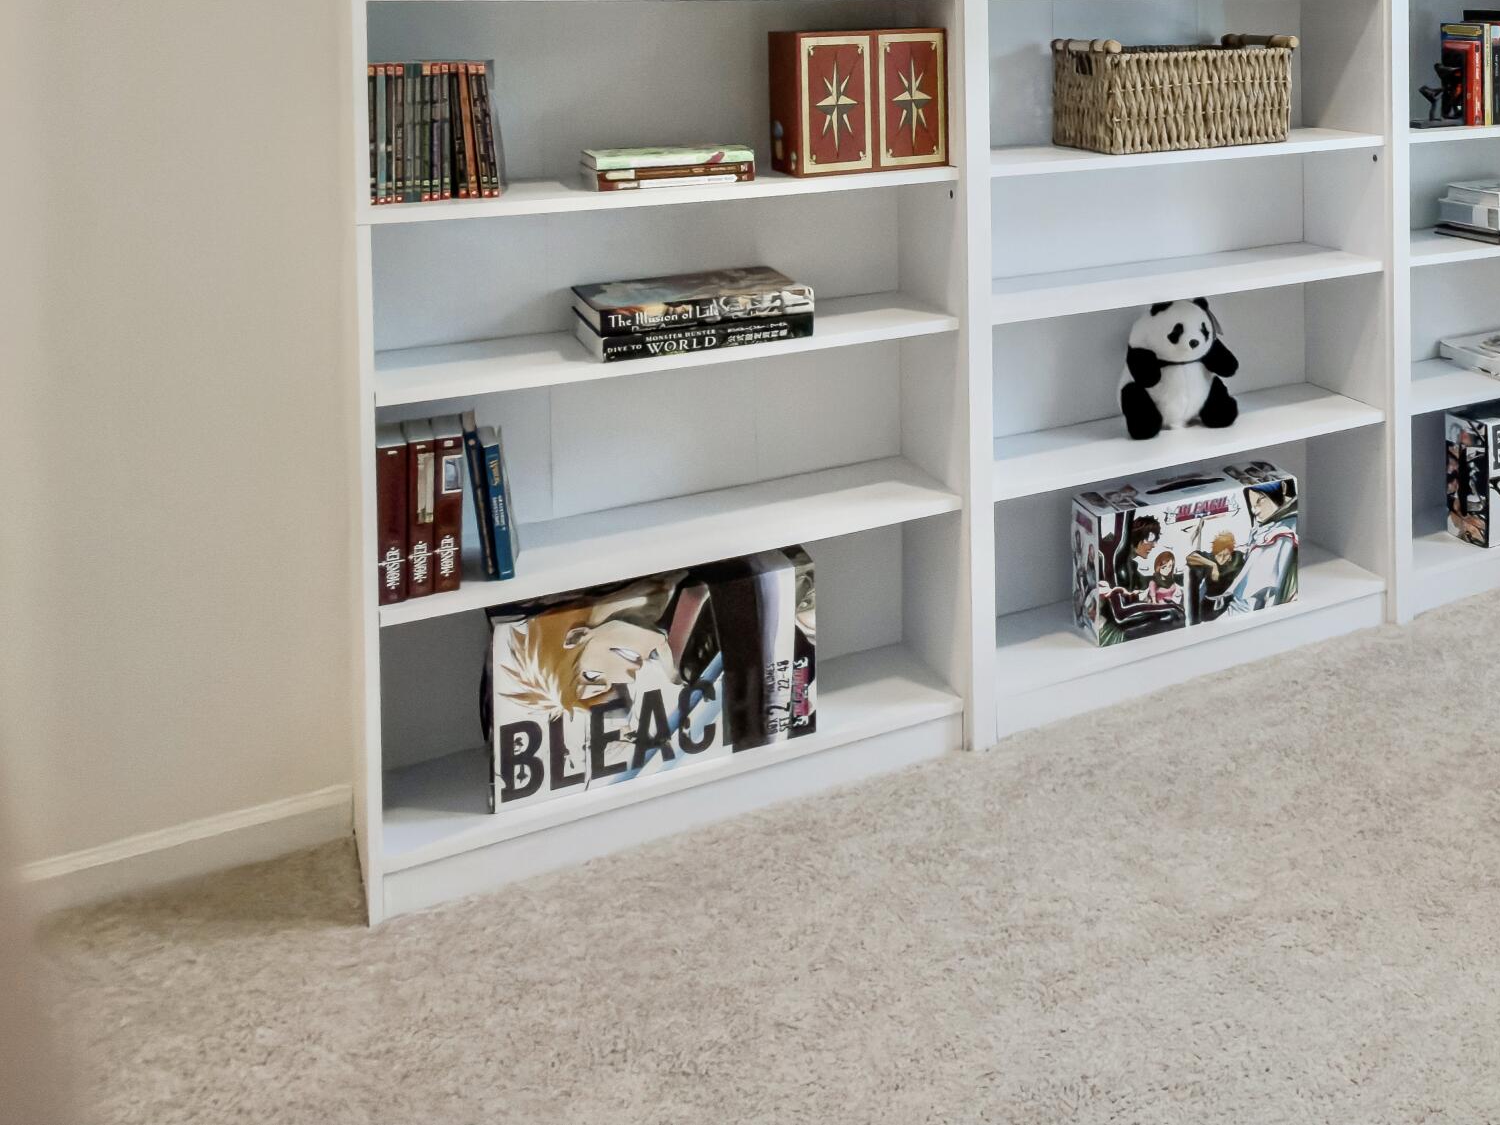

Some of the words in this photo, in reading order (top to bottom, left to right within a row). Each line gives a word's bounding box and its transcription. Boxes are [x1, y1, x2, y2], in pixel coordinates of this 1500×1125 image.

[608, 314, 632, 327] The
[635, 311, 678, 325] Illusion
[681, 304, 692, 319] of
[607, 346, 627, 354] DIVE
[647, 336, 717, 354] WORLD
[645, 333, 682, 342] MONSTER
[685, 329, 716, 338] HUNTER
[777, 659, 790, 692] 22-48
[500, 679, 733, 803] BLEAC
